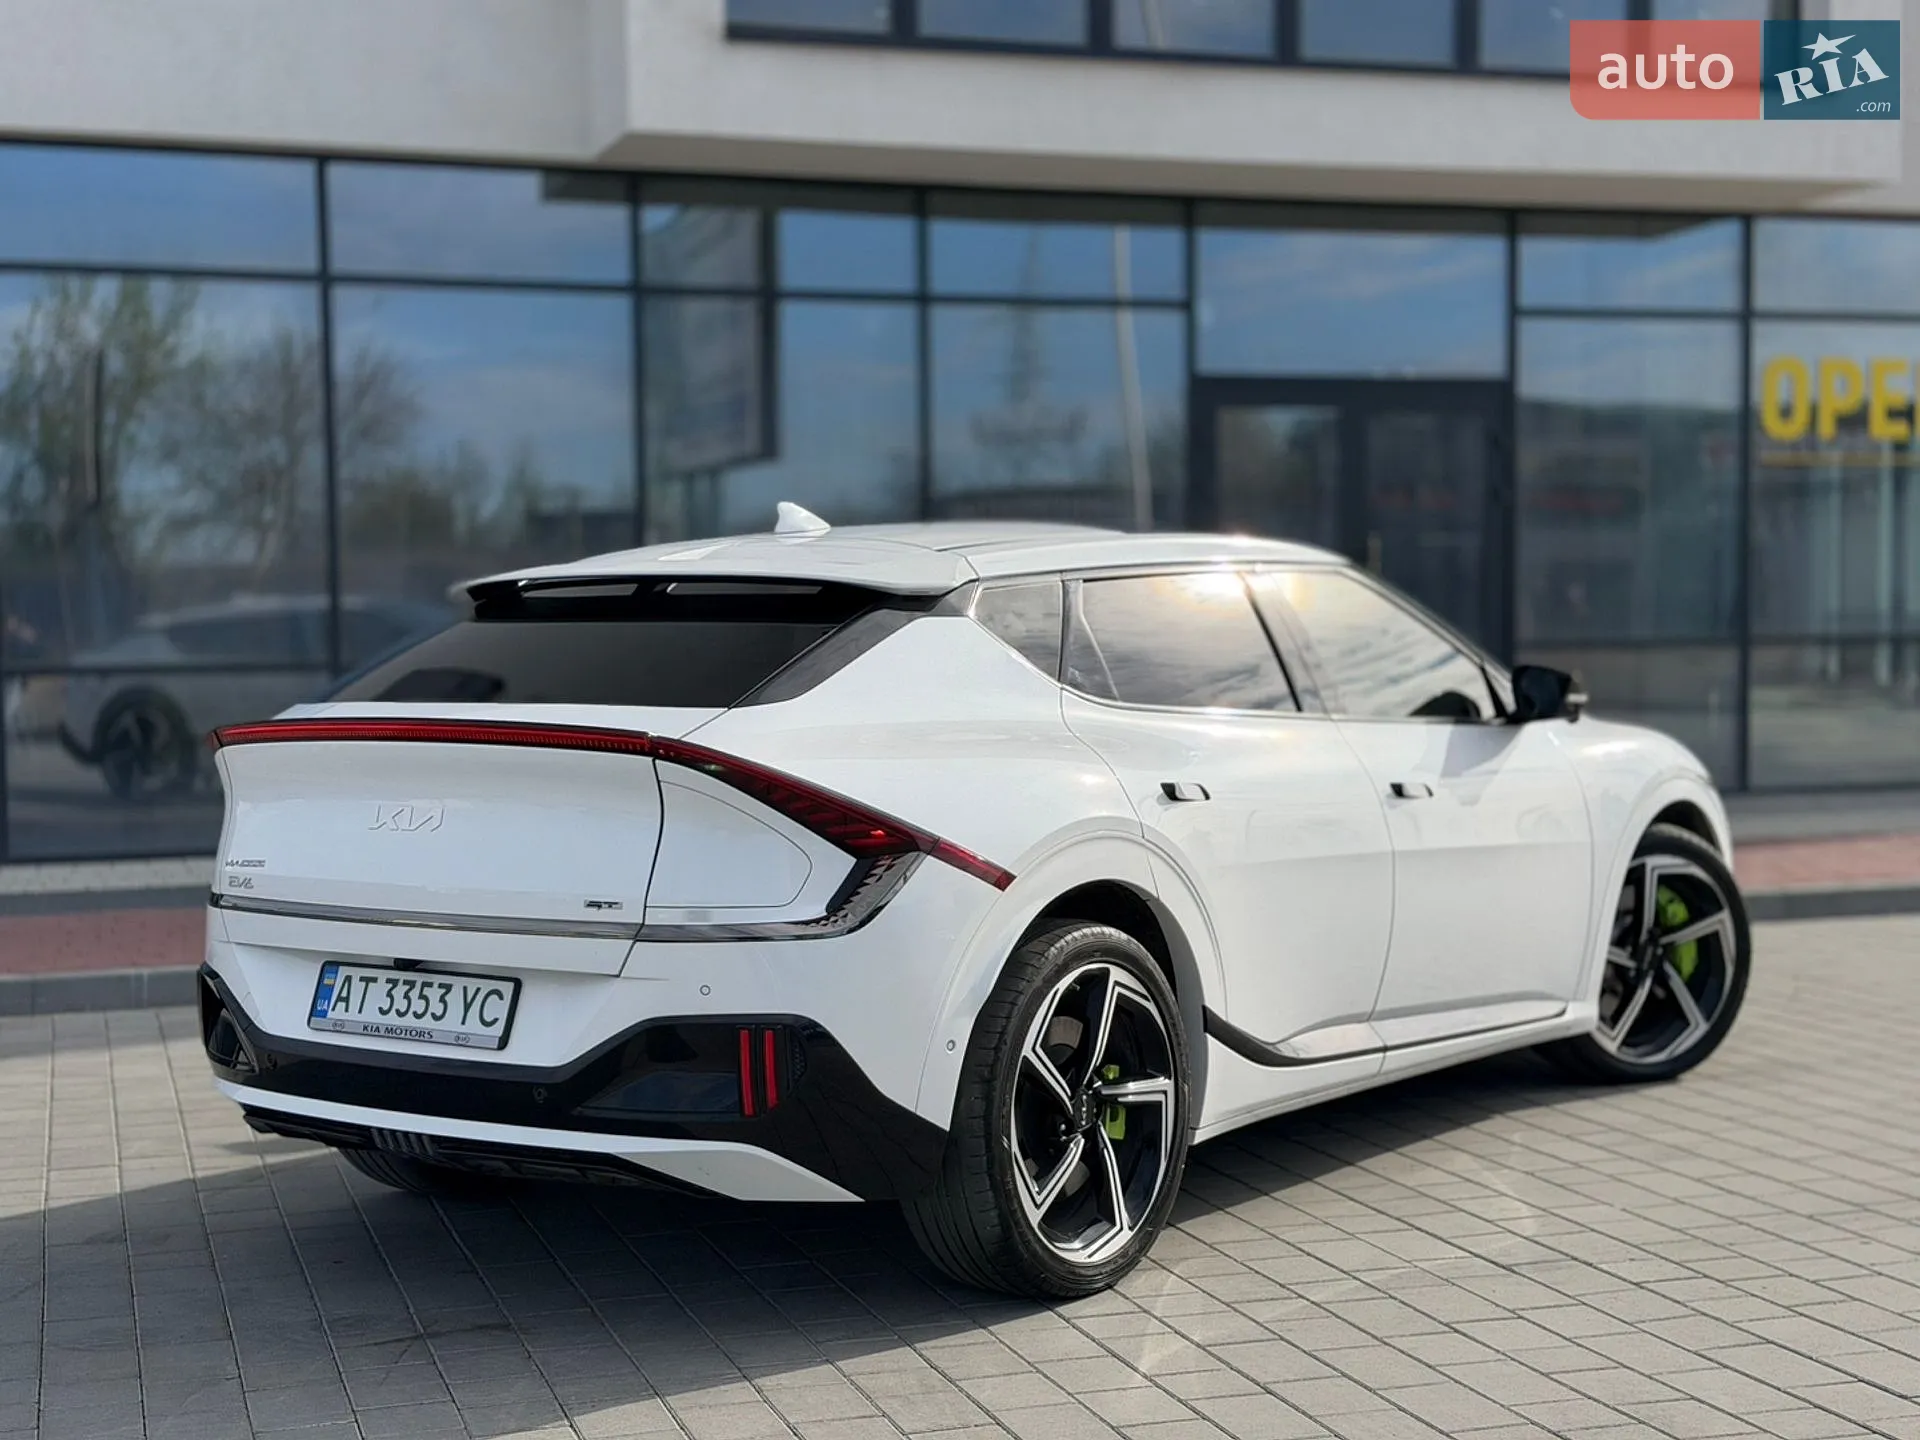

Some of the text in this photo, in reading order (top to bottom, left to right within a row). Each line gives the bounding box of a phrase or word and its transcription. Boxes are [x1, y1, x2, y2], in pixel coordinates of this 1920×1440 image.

[1760, 354, 1920, 442] OPE
[367, 804, 447, 833] KIA
[330, 974, 505, 1028] AT 3353 YC
[362, 1023, 434, 1040] KIA MOTORS
